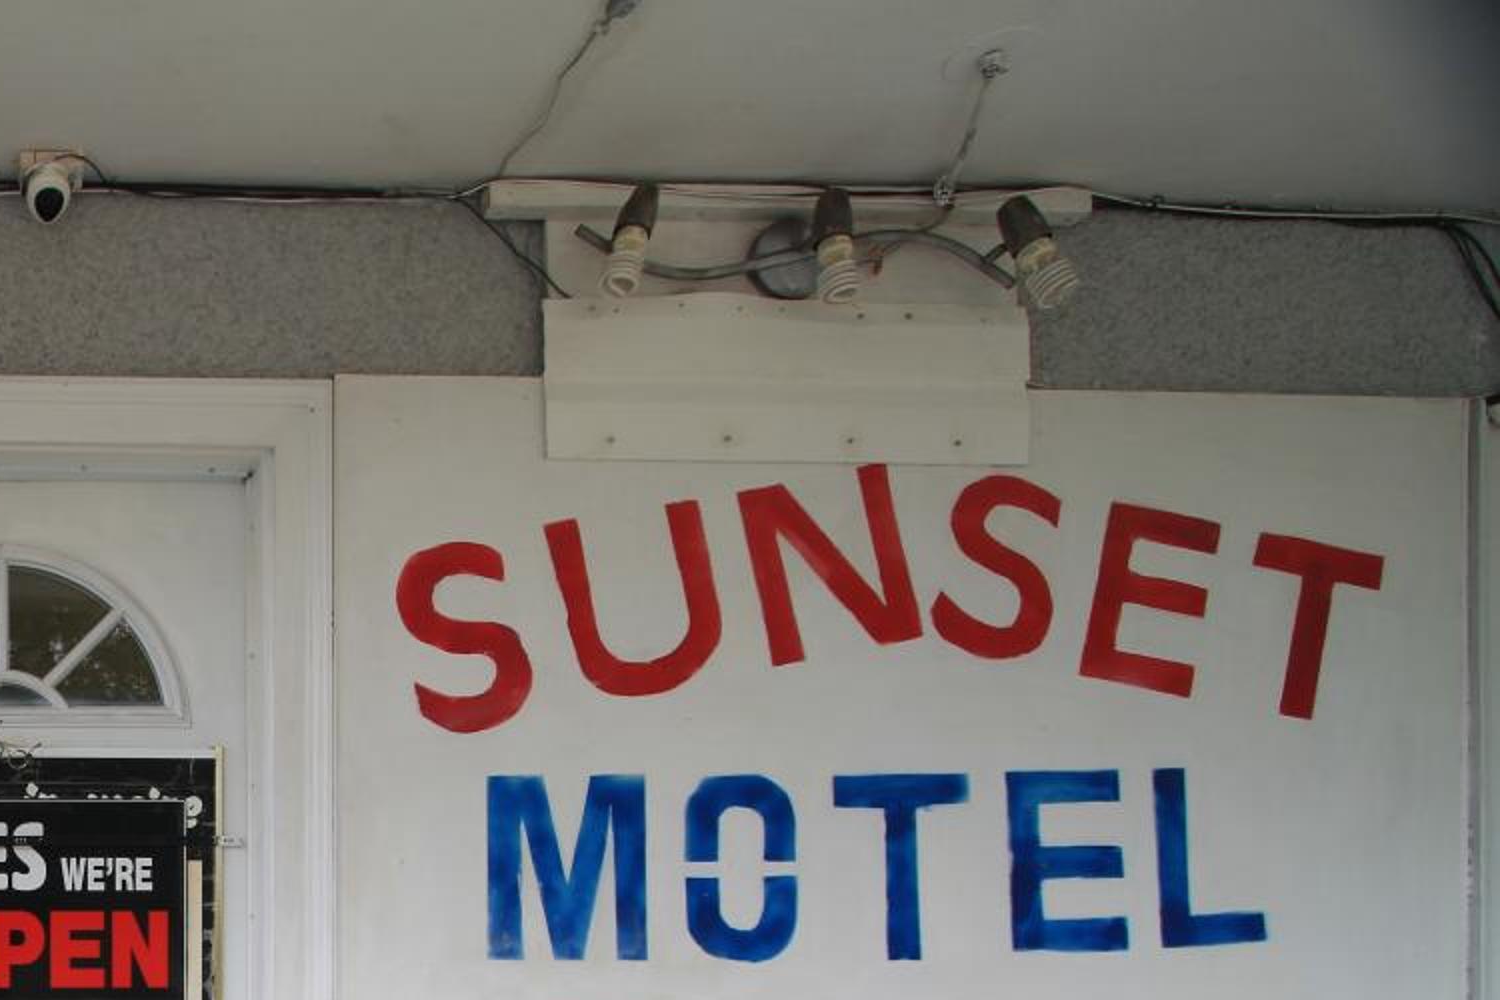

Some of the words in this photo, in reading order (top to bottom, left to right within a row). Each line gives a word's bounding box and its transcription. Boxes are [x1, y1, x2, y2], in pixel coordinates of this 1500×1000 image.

[396, 463, 1384, 733] SUNSET
[60, 857, 153, 891] WE'RE
[486, 767, 1267, 962] MOTEL
